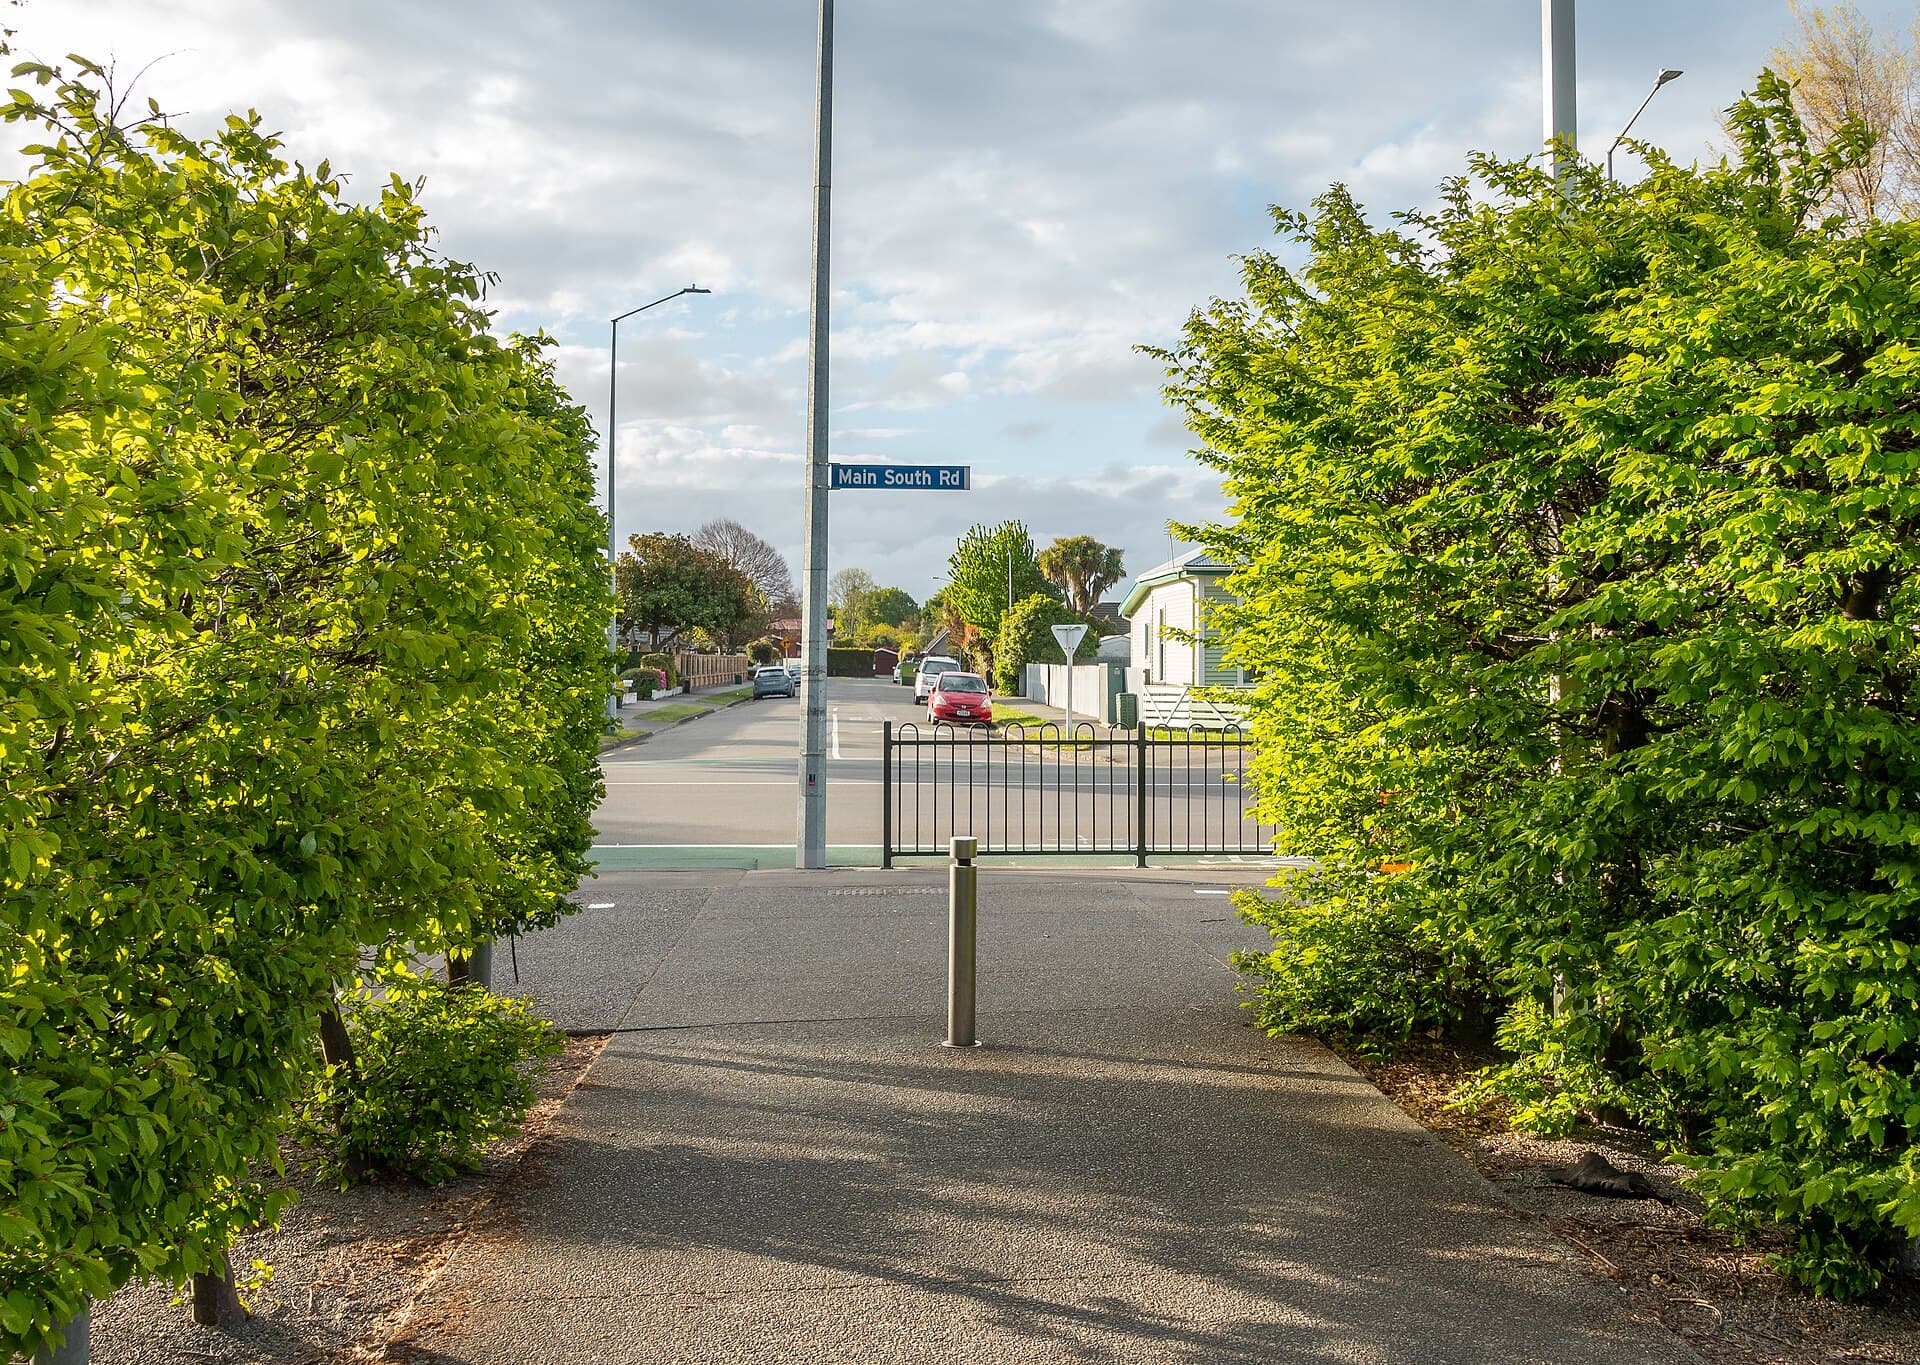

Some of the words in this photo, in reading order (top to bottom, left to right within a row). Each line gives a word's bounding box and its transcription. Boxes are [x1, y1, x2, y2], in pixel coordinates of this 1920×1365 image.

[838, 468, 877, 485] Main
[884, 469, 932, 486] South
[939, 470, 960, 486] Rd
